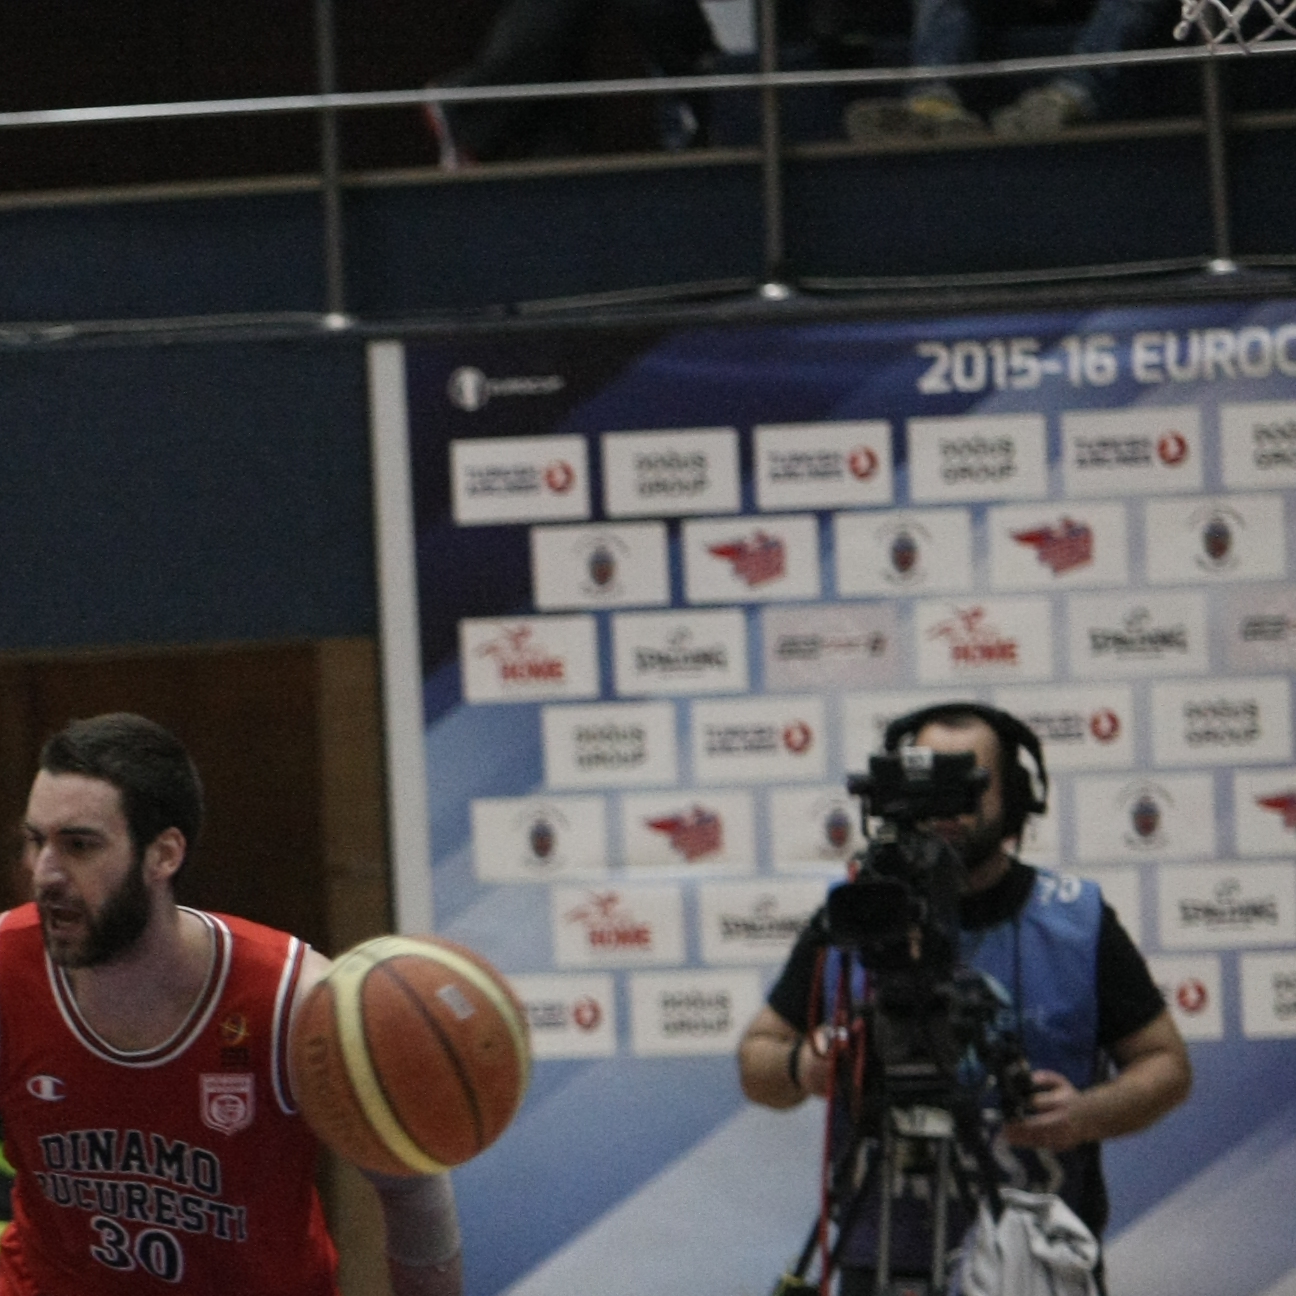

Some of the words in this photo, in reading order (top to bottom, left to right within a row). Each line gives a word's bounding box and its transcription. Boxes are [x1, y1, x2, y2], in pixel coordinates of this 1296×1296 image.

[916, 333, 1118, 395] 2015-16
[38, 1129, 221, 1196] DINAMO
[90, 1215, 184, 1283] 30
